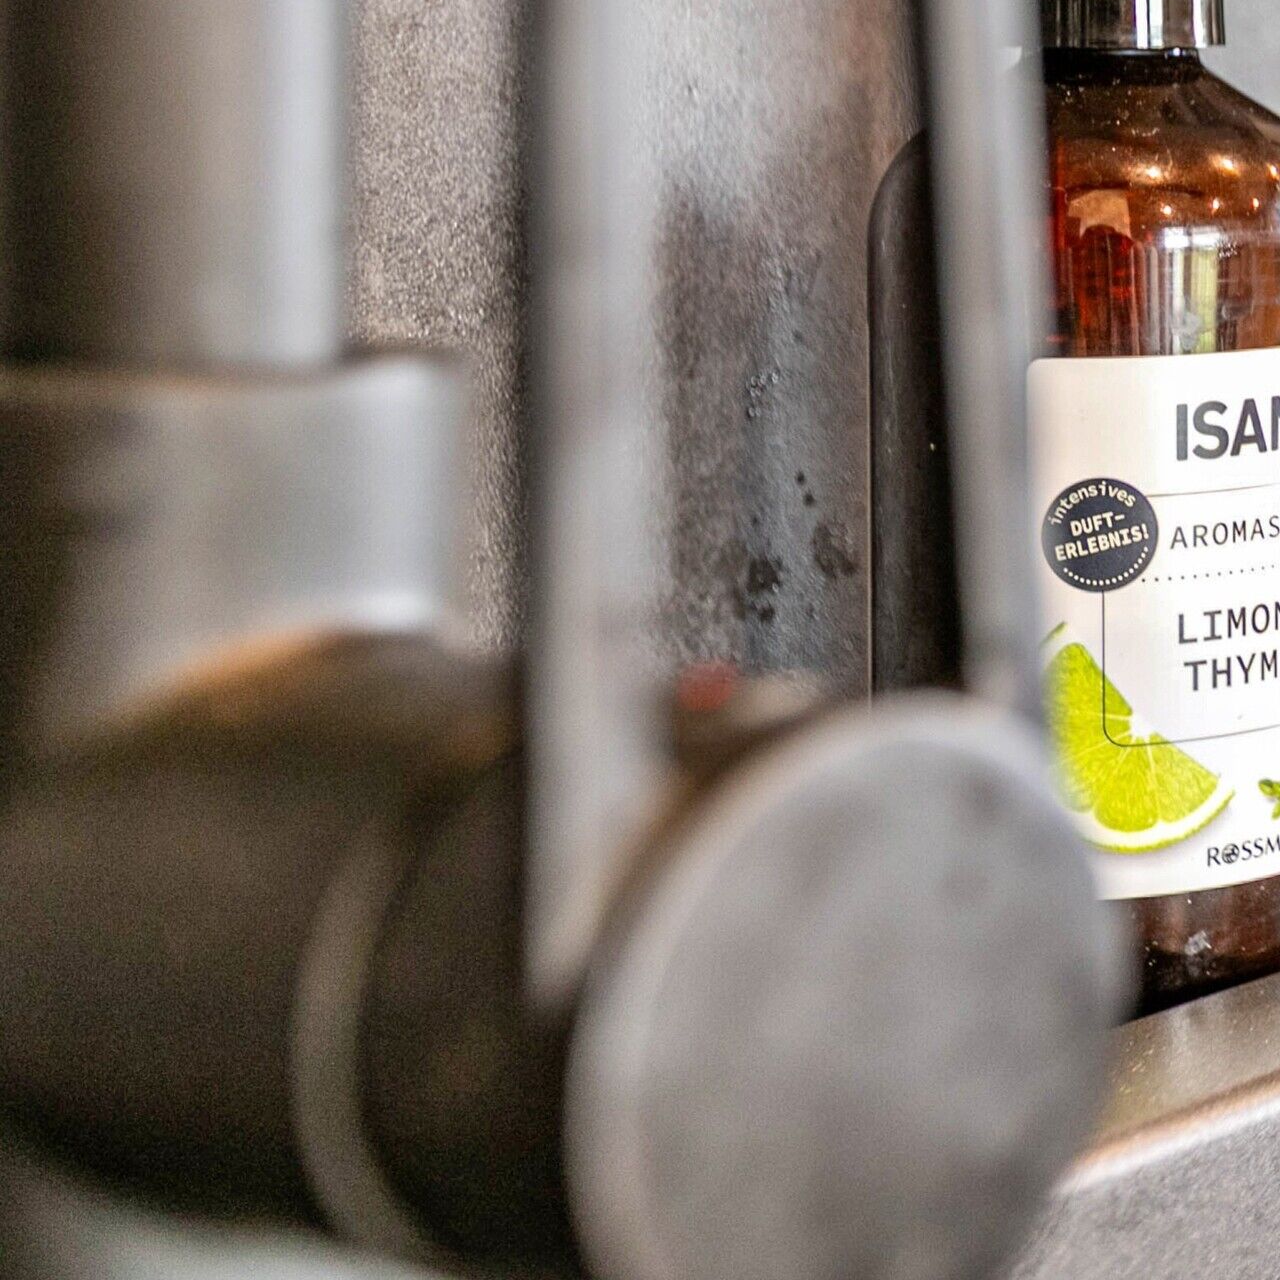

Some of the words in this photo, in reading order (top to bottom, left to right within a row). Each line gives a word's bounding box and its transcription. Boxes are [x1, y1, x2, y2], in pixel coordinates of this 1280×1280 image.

[1048, 480, 1136, 526] intensives
[1054, 523, 1149, 561] ERLEBNIS!
[1070, 511, 1125, 537] DUFT-
